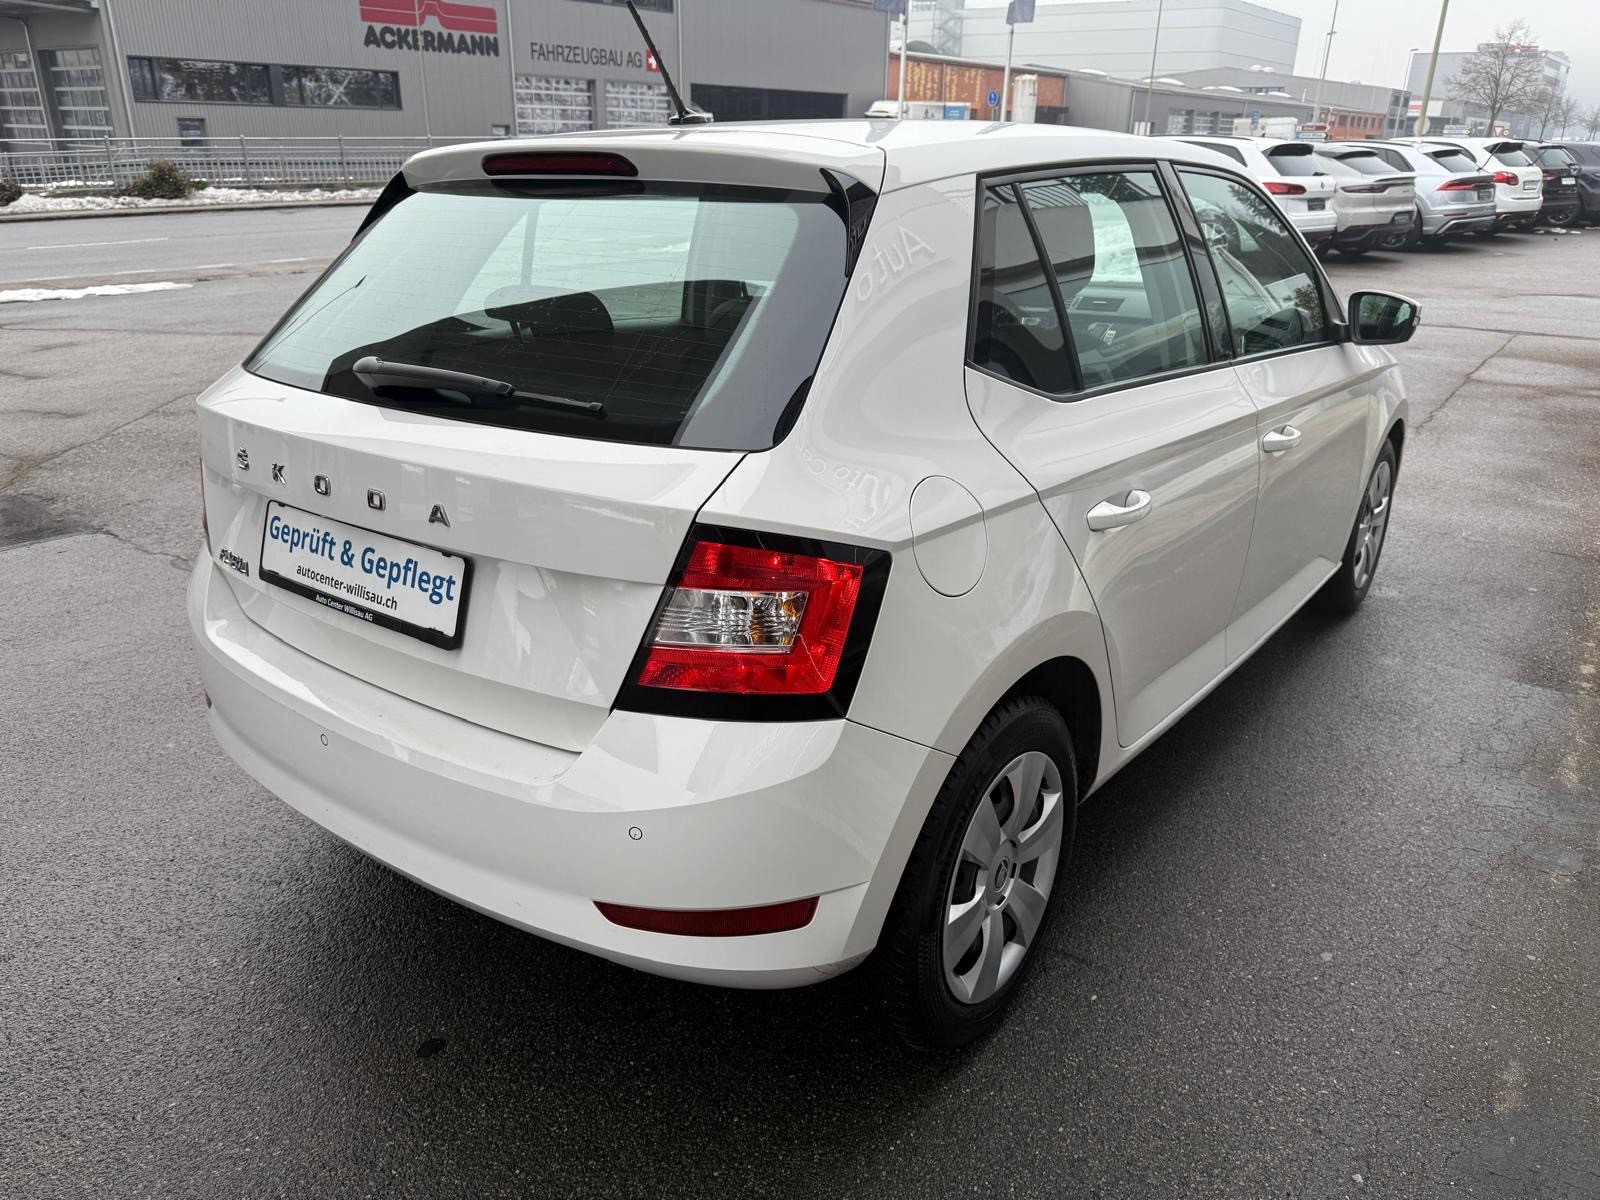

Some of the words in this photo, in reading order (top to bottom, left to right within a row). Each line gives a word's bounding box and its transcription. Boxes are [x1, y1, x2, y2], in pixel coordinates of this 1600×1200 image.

[364, 24, 499, 57] ACKERMANN
[530, 42, 624, 67] FAHRZEUGBAU
[627, 51, 643, 68] AG
[269, 515, 336, 561] Geprüft
[340, 539, 355, 568] &
[361, 546, 456, 605] Gepflegt
[296, 564, 398, 611] autocenter-willisau.ch
[315, 594, 328, 605] Auto
[327, 598, 344, 611] Center
[344, 604, 364, 618] Willisau
[364, 612, 374, 622] AG
